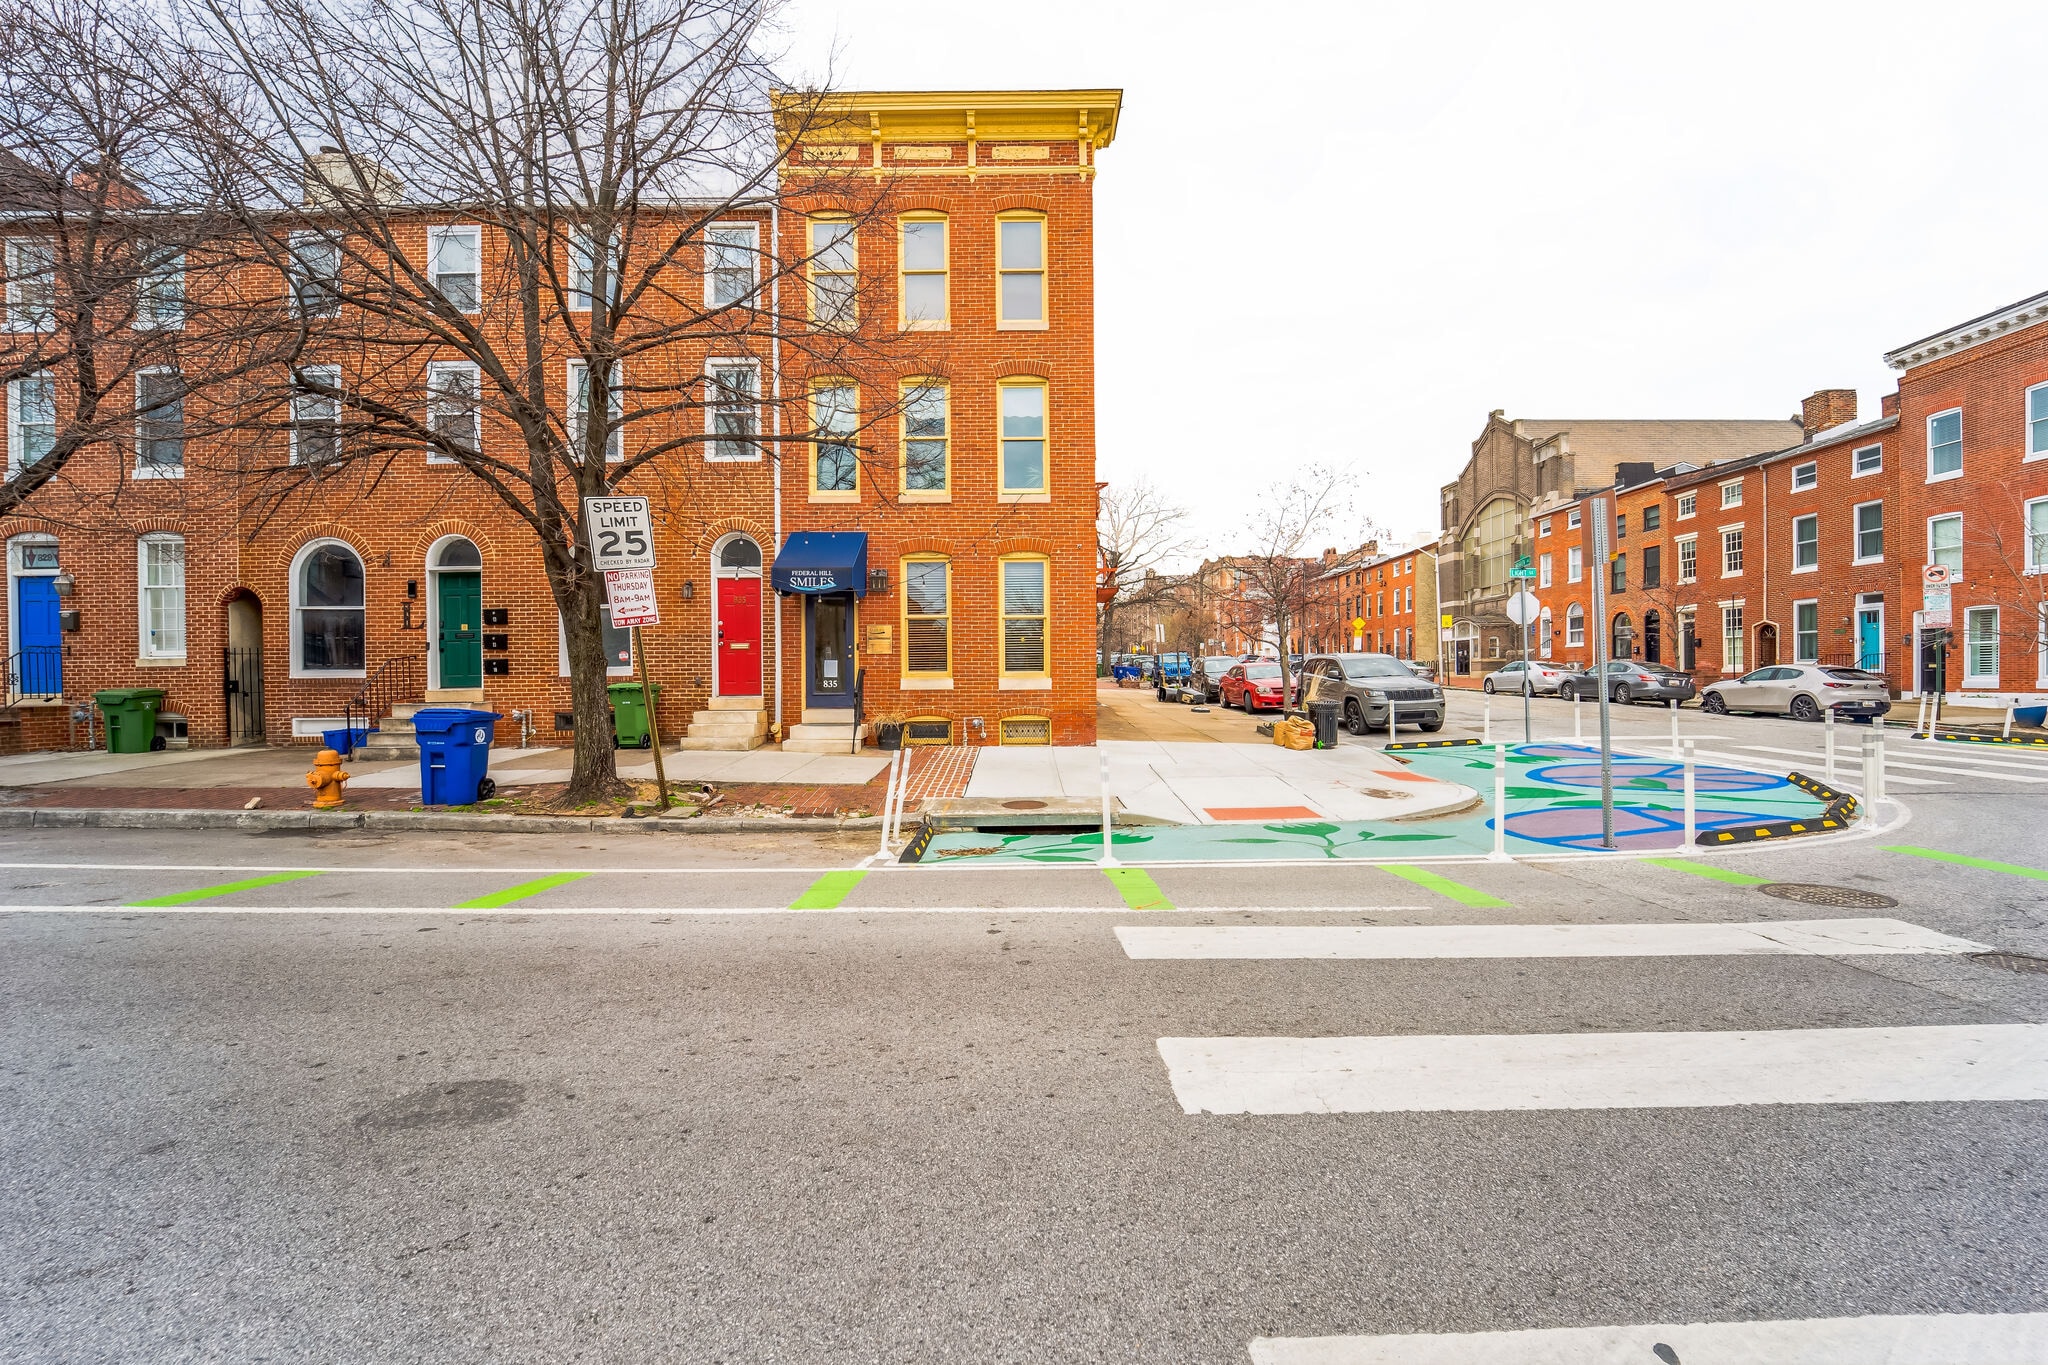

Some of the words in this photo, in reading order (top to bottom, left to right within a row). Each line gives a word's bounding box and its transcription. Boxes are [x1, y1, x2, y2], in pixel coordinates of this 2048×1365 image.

[592, 502, 643, 513] SPEED
[600, 516, 638, 528] LIMIT
[597, 530, 647, 557] 25
[606, 571, 619, 582] NO
[620, 570, 650, 580] PARKING
[1511, 569, 1527, 577] LIGHT
[612, 581, 648, 592] THURSDAY
[789, 576, 835, 587] SMILES
[613, 593, 650, 604] 8AM-9AM
[613, 619, 626, 627] TOW
[626, 617, 641, 626] AWAY
[823, 680, 838, 688] 835
